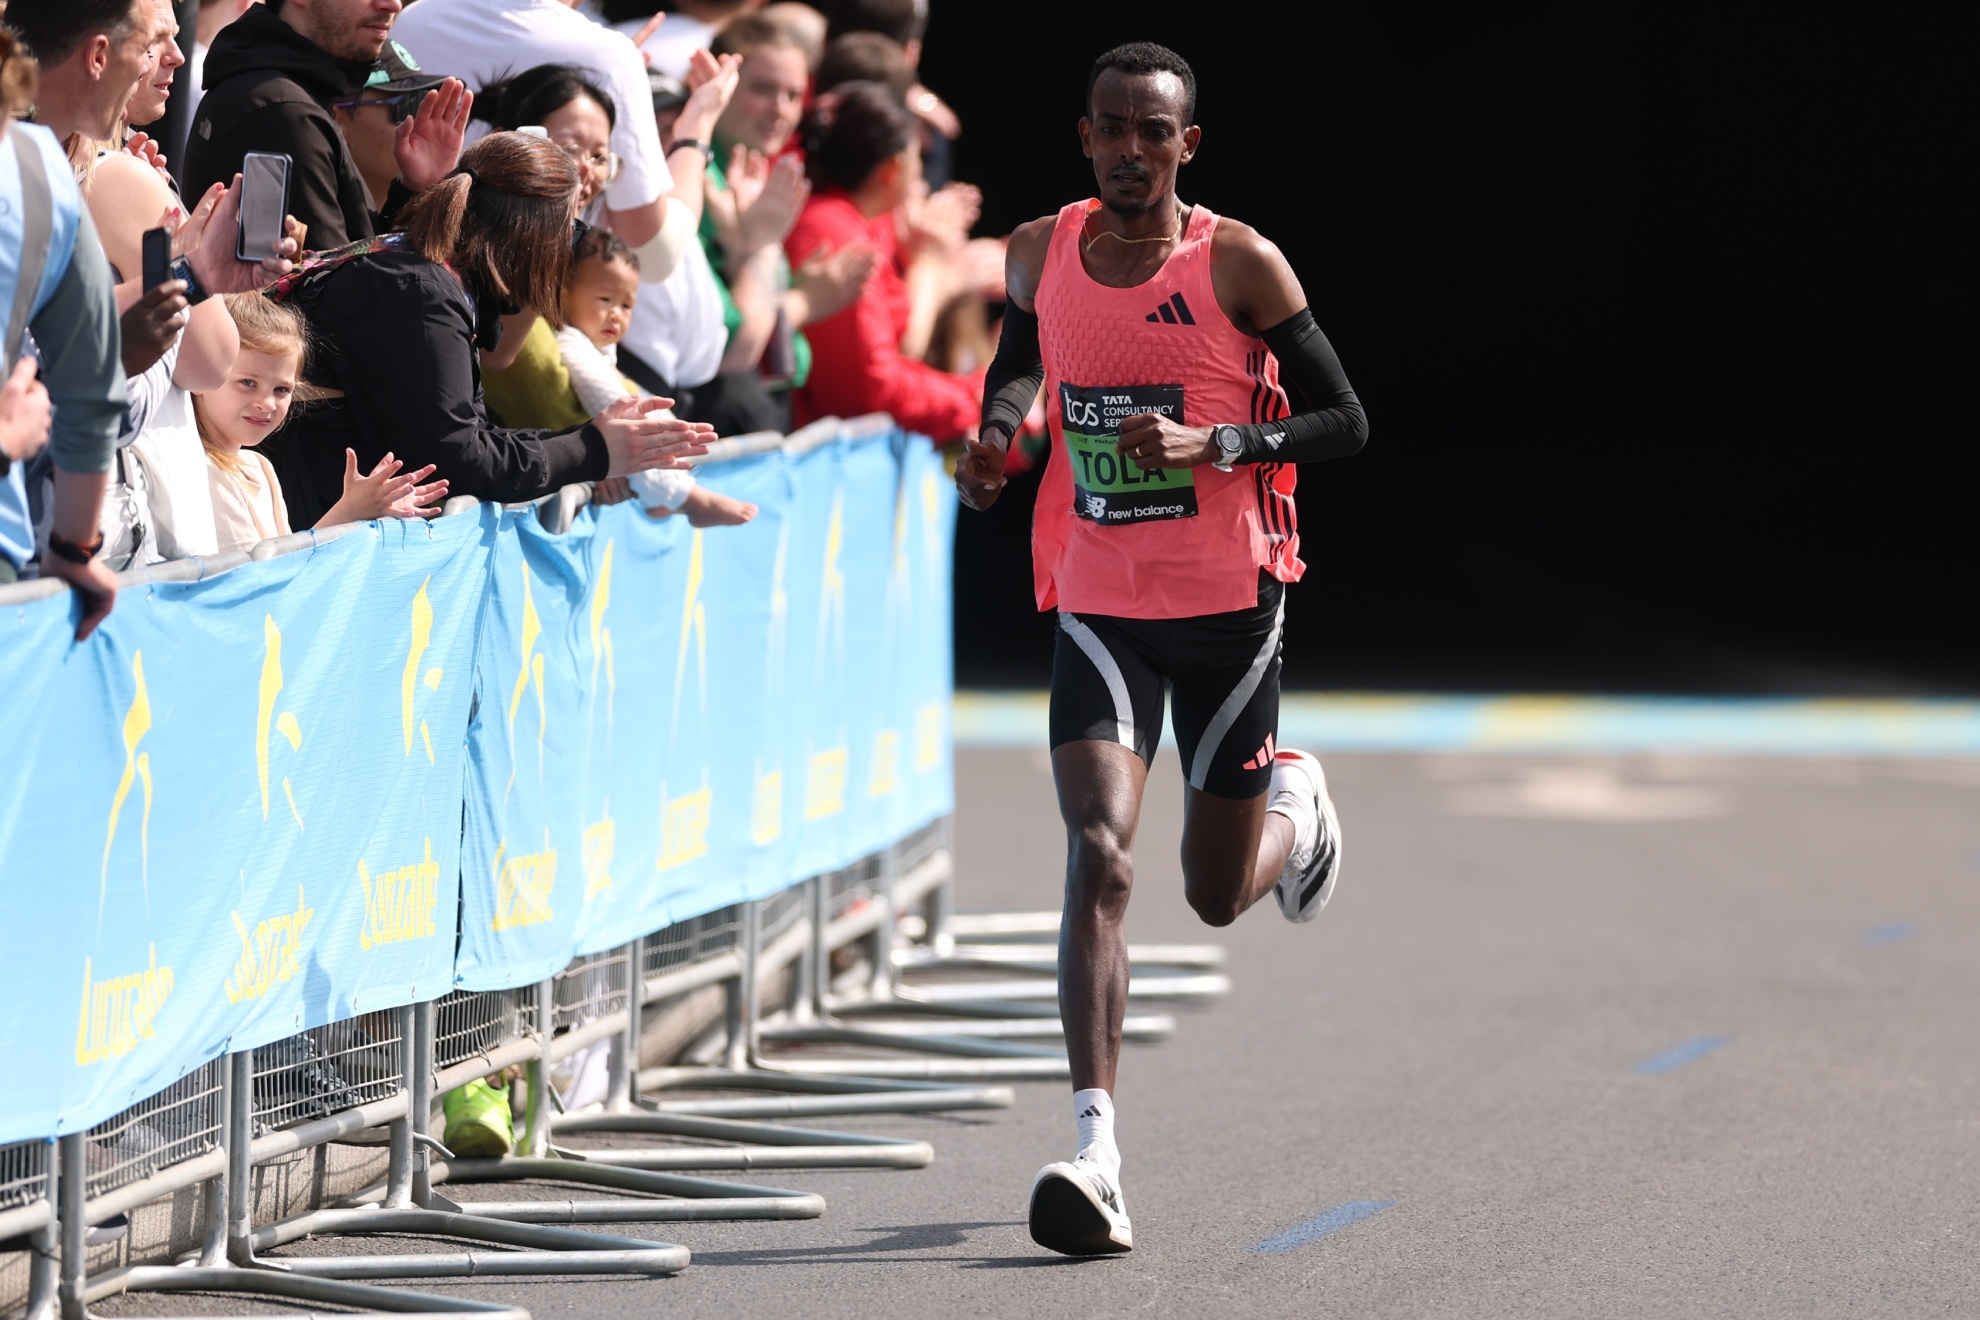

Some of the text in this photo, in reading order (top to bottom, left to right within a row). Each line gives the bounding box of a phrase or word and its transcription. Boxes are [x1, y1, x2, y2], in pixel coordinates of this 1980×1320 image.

[1102, 395, 1133, 405] TATA
[1064, 390, 1099, 427] tcs
[1103, 405, 1174, 417] CONSULTANCY
[1108, 504, 1184, 519] new balance
